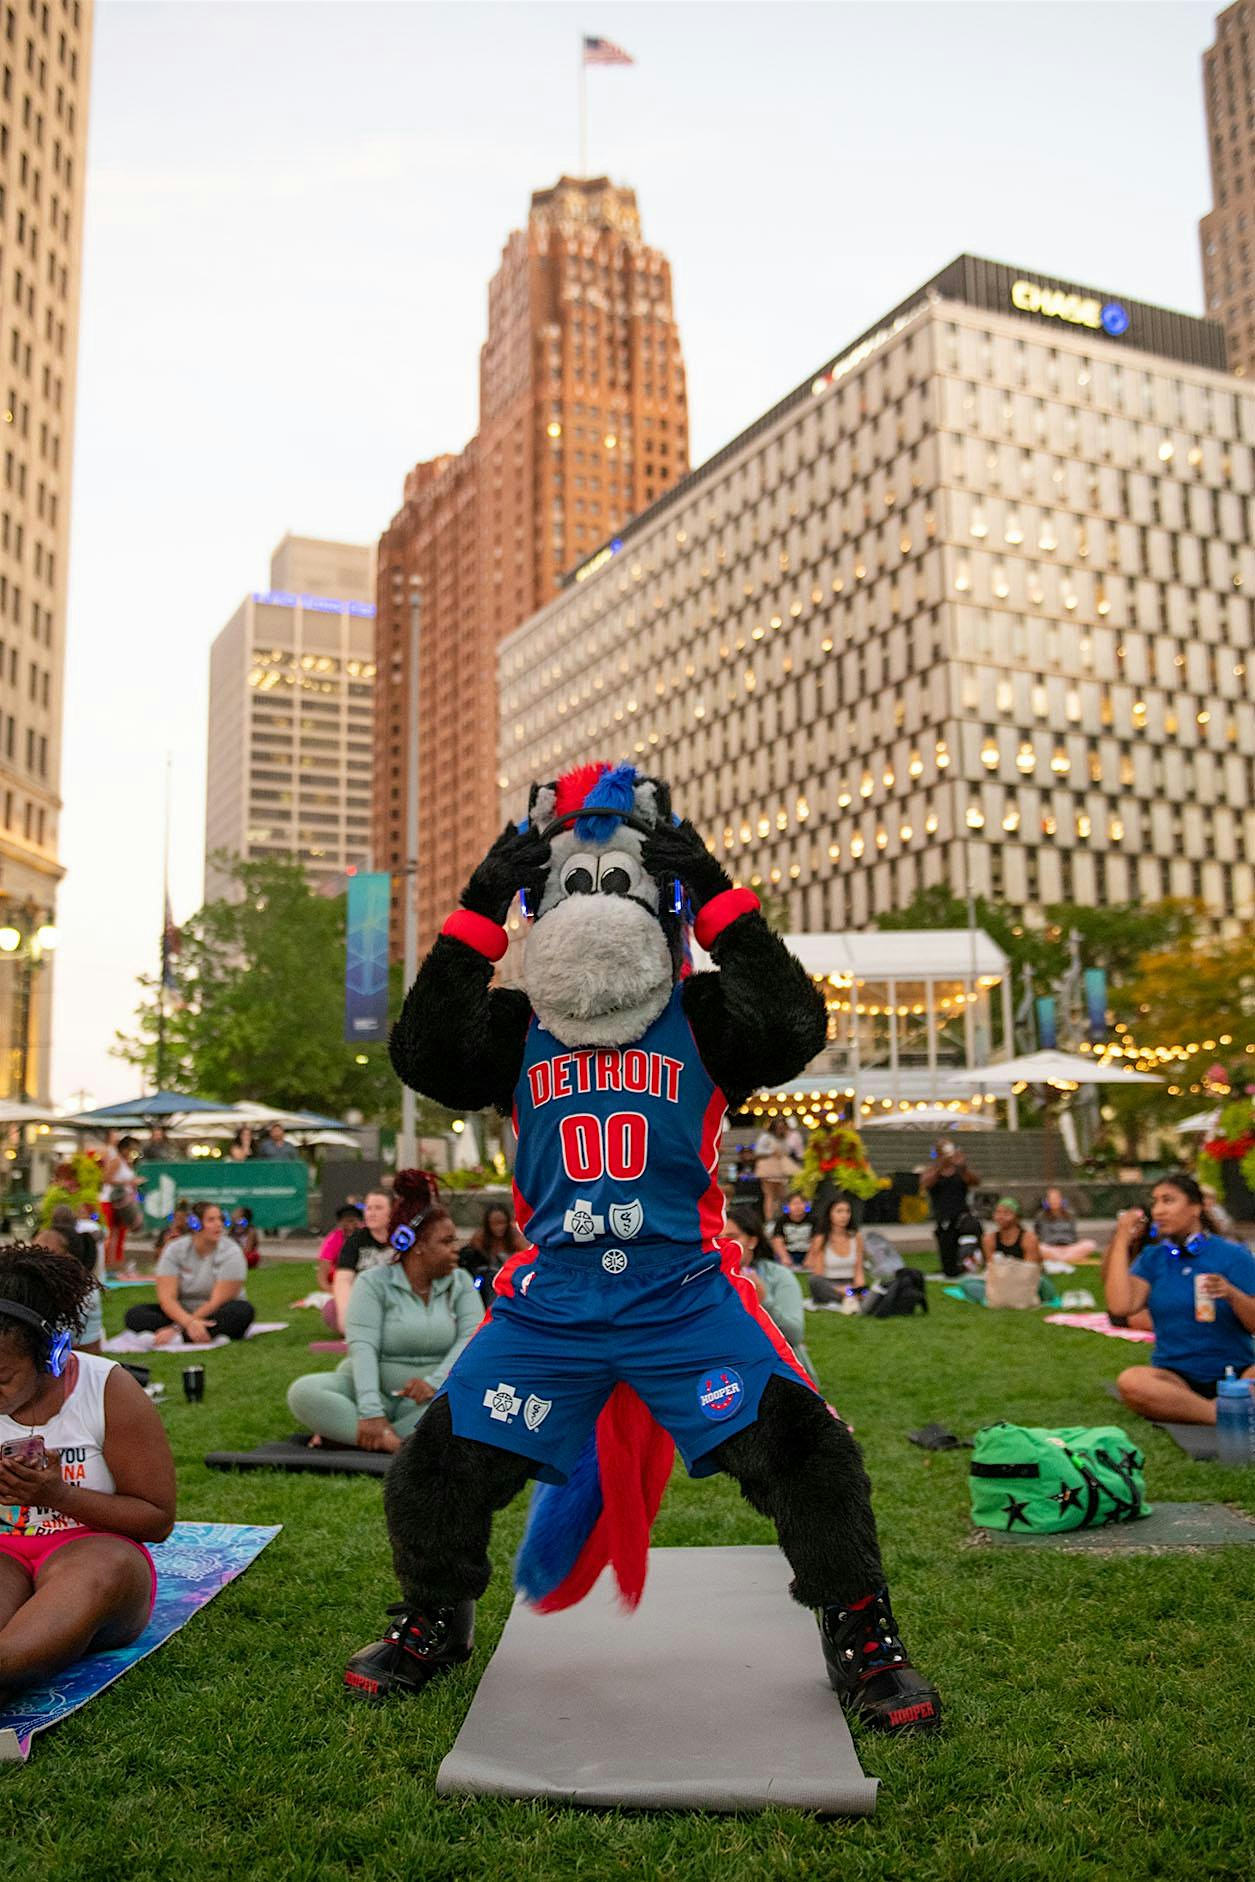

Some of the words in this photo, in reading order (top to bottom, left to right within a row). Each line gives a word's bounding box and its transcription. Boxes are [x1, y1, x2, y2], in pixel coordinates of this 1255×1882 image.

[528, 1048, 685, 1109] DETROIT
[560, 1111, 648, 1182] 00
[700, 1382, 741, 1406] HOOPER
[57, 1447, 86, 1464] YOU
